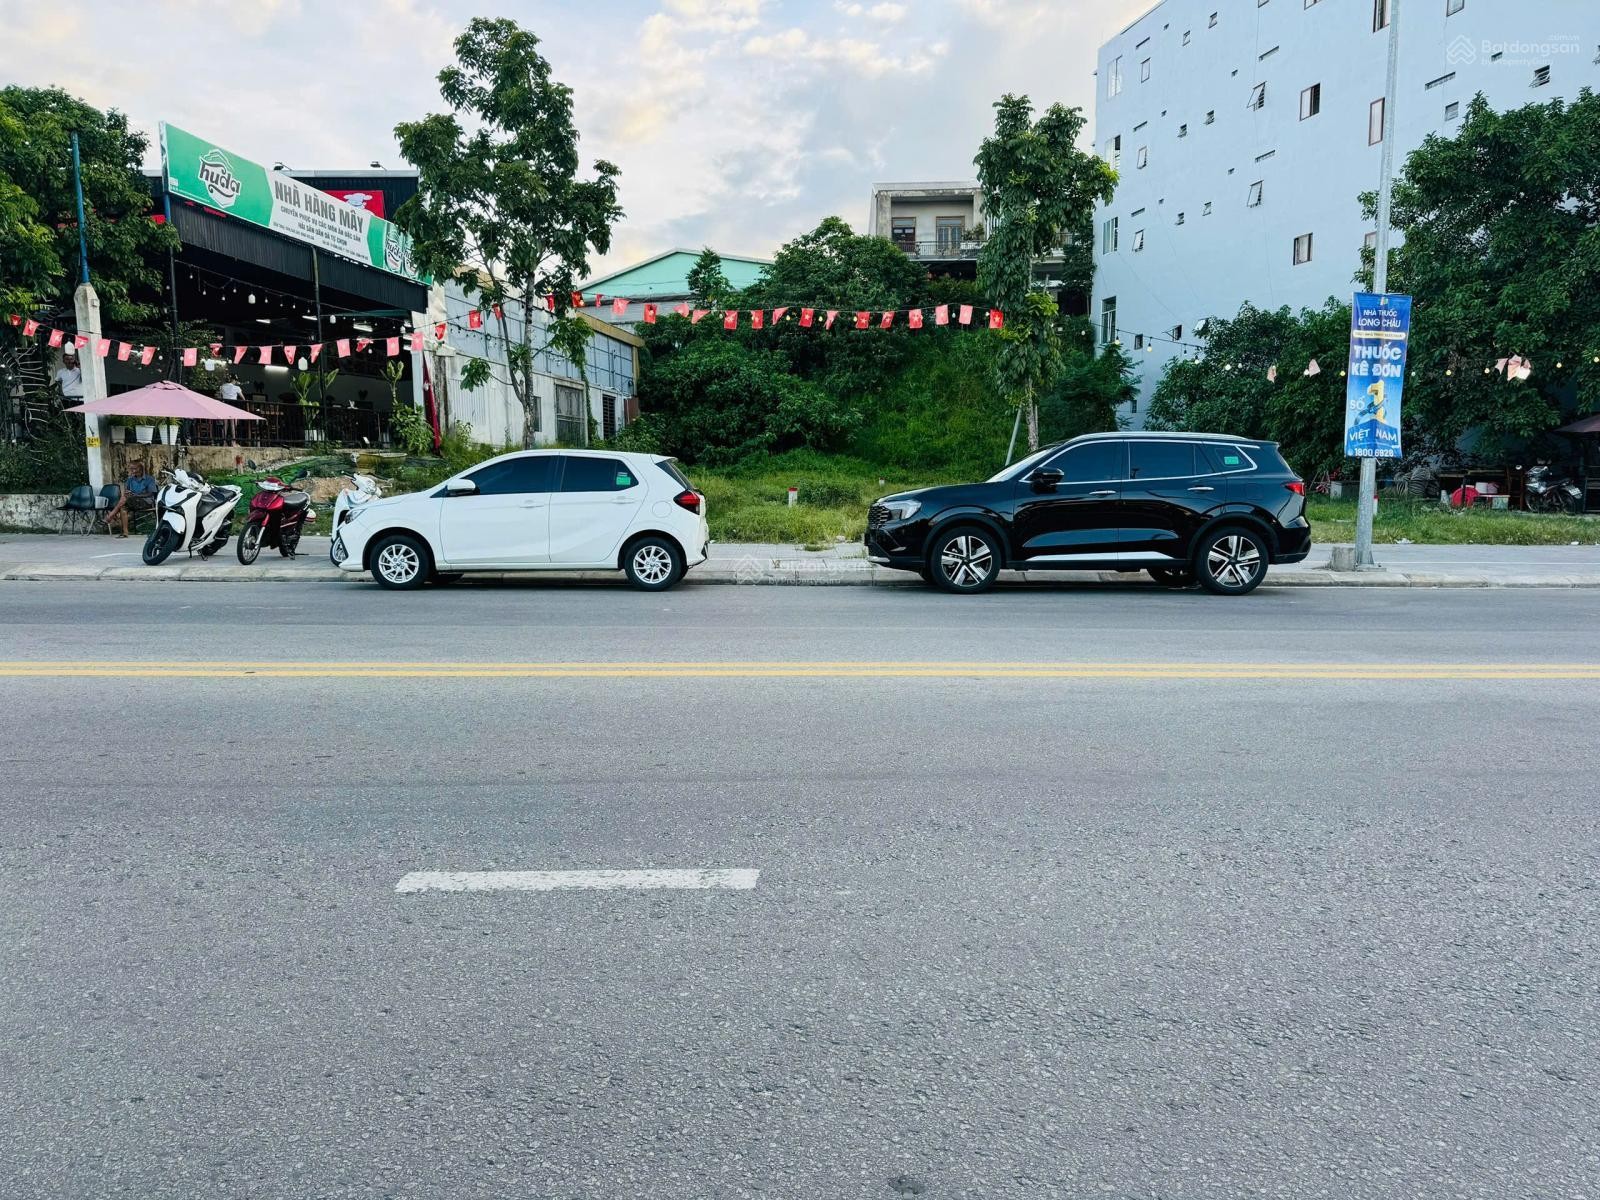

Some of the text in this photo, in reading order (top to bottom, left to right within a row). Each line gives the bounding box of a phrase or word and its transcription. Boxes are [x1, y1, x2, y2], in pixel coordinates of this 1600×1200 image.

[199, 158, 241, 197] huda
[274, 180, 301, 208] NHÀ
[304, 193, 336, 223] HÀNG
[339, 208, 364, 234] MÂY
[1363, 307, 1397, 317] NHÀ THUỐC
[1358, 318, 1402, 328] LONG CHÂU
[1353, 342, 1402, 360] THUỐC
[1351, 359, 1402, 377] KÊ ĐƠN
[1349, 396, 1365, 410] SỐ
[1349, 428, 1397, 442] VIỆT NAM
